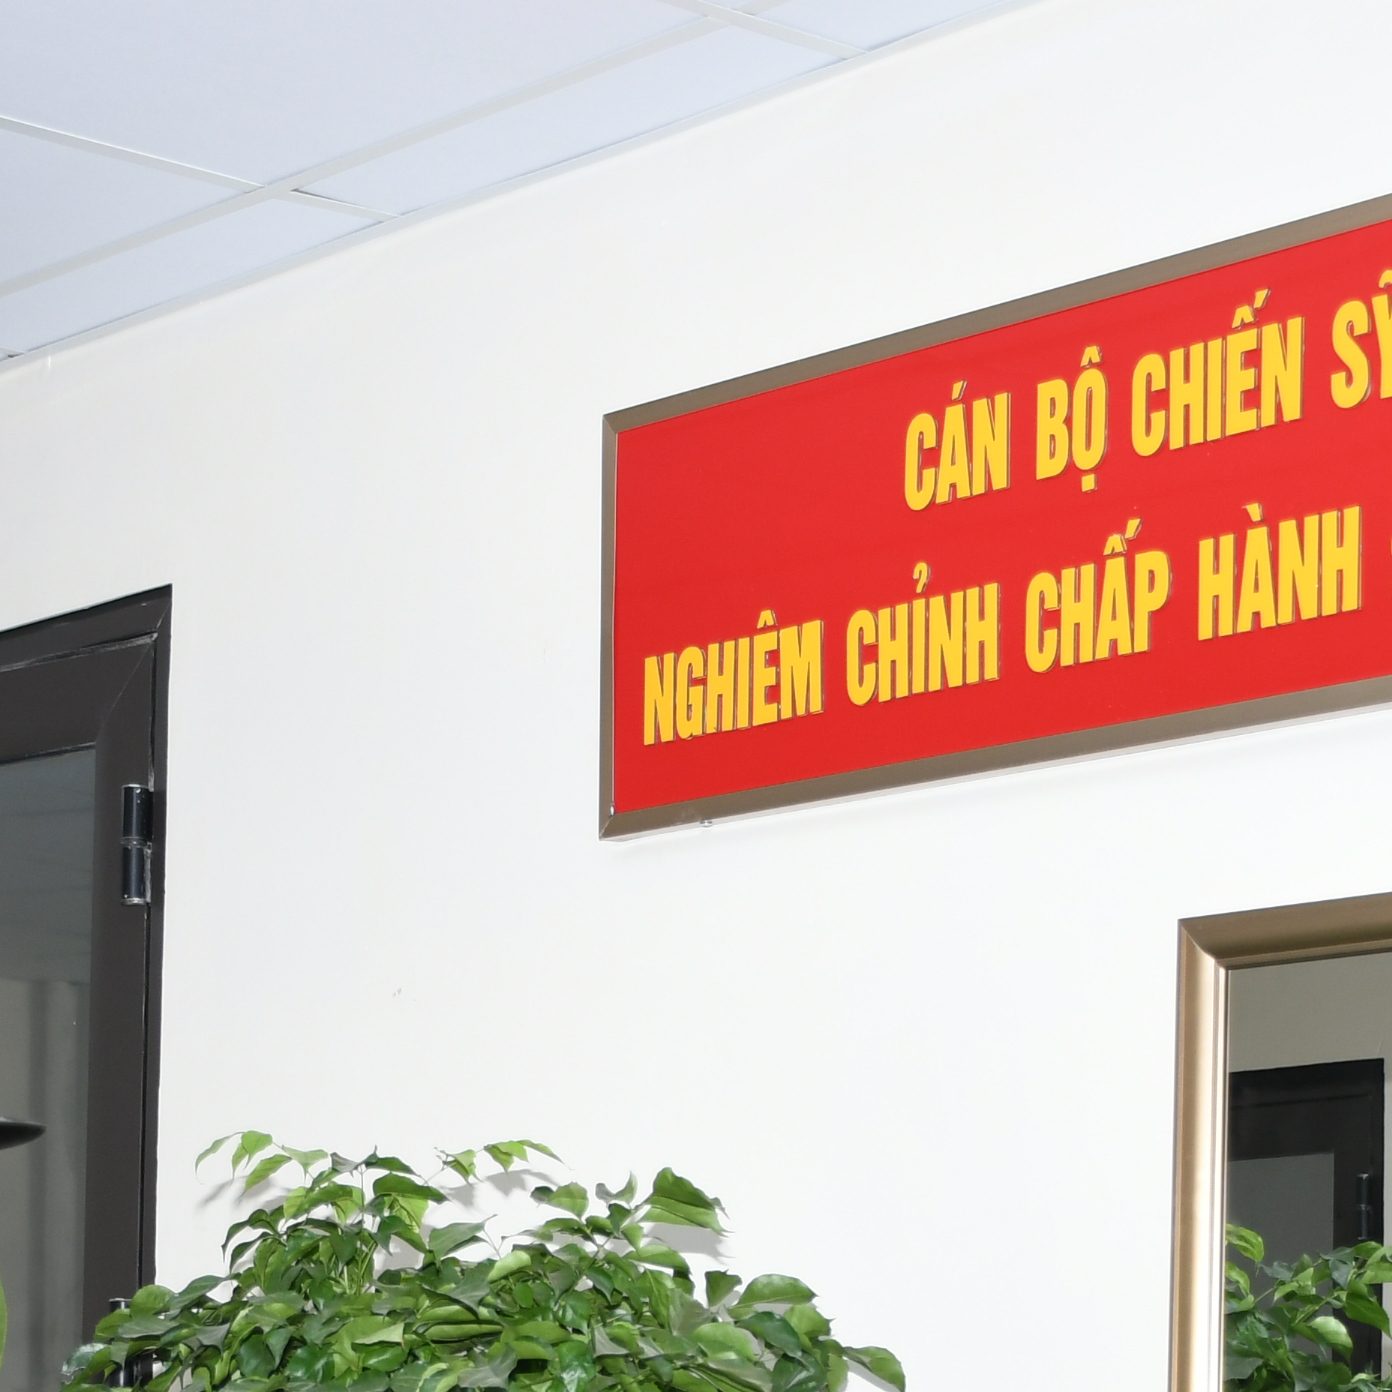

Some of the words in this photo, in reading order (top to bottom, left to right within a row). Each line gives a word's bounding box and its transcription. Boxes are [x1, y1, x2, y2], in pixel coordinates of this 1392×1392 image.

[904, 380, 1012, 512] CÁN
[1035, 344, 1108, 492] BỘ
[1131, 288, 1305, 457] CHIẾN
[643, 609, 824, 746] NGHIÊM
[846, 561, 1000, 706] CHỈNH
[1024, 517, 1172, 673] CHẤP
[1197, 502, 1362, 641] HÀNH
